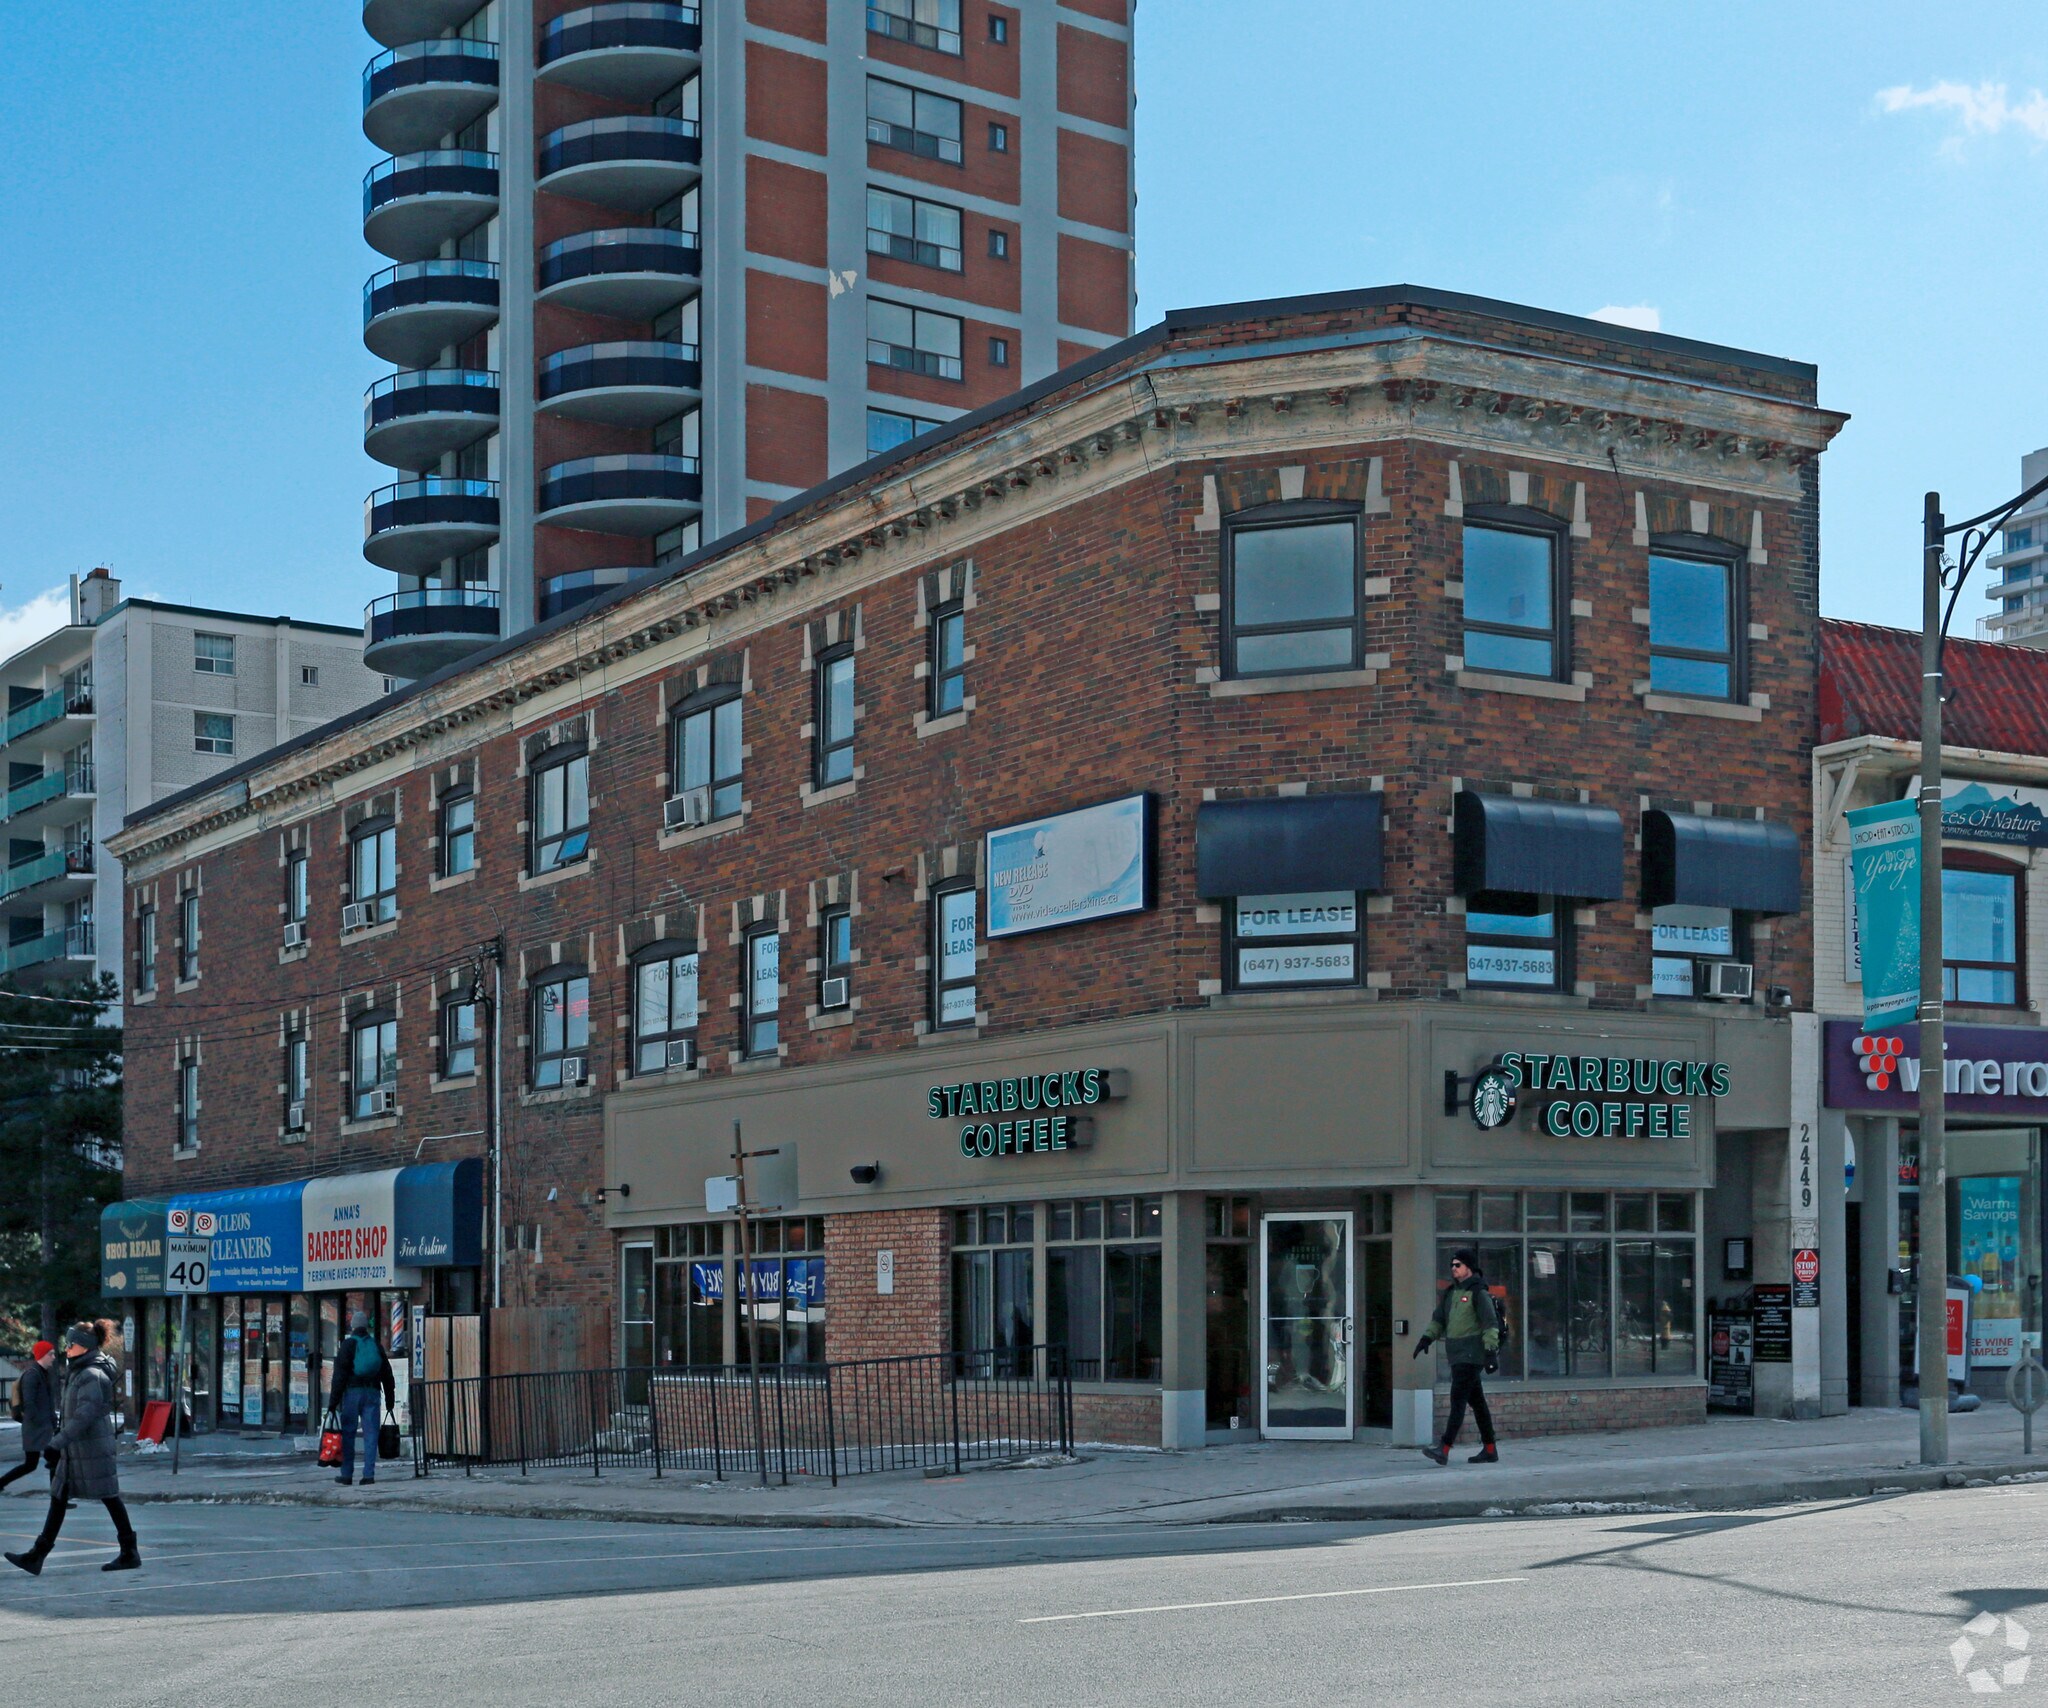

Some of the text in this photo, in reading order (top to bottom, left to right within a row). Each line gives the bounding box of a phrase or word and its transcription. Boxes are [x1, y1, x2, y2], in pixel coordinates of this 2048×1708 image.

[1969, 804, 1998, 826] Of
[1992, 811, 2041, 832] Nature
[1854, 830, 1874, 844] SHOP
[1890, 823, 1915, 838] STROLL
[993, 861, 1049, 889] NEW RELEASE
[1860, 852, 1917, 894] Yonge
[1008, 883, 1034, 899] DVD
[951, 916, 975, 933] FOR
[1239, 906, 1353, 926] FOR LEASE
[1682, 926, 1729, 942] LEASE
[944, 938, 976, 956] LEAS
[675, 963, 698, 979] LEAS
[1243, 955, 1350, 973] (647) 937-5683
[1468, 957, 1553, 974] 647-937-5683
[756, 966, 778, 981] LEAS
[1866, 994, 1919, 1012] uptownyonge.com
[1501, 1051, 1732, 1098] STARBUCKS
[927, 1068, 1100, 1119] STARBUCKS
[1547, 1101, 1691, 1138] COFFEE
[959, 1116, 1067, 1158] COFFEE
[1799, 1123, 1812, 1208] 2449
[333, 1204, 360, 1221] ANNA'S
[1969, 1198, 2011, 1209] Warm
[1963, 1209, 2017, 1222] Savings
[105, 1239, 161, 1260] SHOE REPAIR
[171, 1243, 207, 1254] MAXIMUM
[211, 1235, 272, 1261] CLEANERS
[307, 1225, 388, 1262] BARBER SHOP
[418, 1235, 448, 1257] Erskine
[169, 1261, 206, 1286] 40
[312, 1268, 336, 1282] ERSKINE
[336, 1267, 348, 1280] AVE
[348, 1266, 387, 1279] 647-797-2279
[1796, 1261, 1816, 1270] STOP
[1985, 1337, 2013, 1347] WINE
[1971, 1347, 2009, 1357] AMPLES
